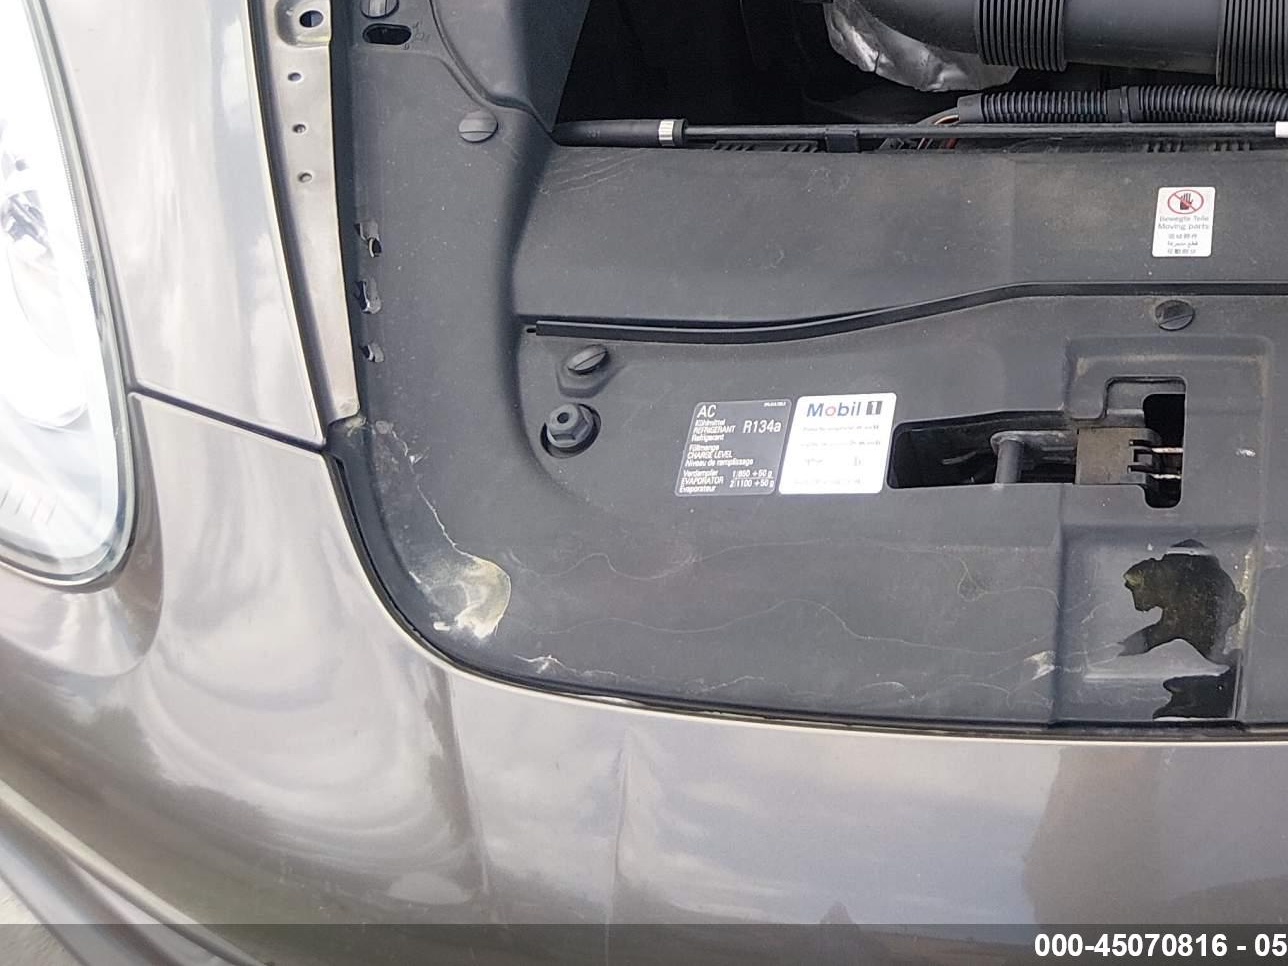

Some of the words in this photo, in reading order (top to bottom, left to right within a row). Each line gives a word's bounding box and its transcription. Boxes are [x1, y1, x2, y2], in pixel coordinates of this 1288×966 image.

[697, 404, 717, 418] AC
[806, 401, 861, 417] Mobil
[866, 400, 883, 415] 1
[743, 419, 782, 433] R134a
[687, 451, 712, 459] CHARGE
[714, 450, 732, 458] LEVEL
[681, 476, 724, 485] EVAPORATOR
